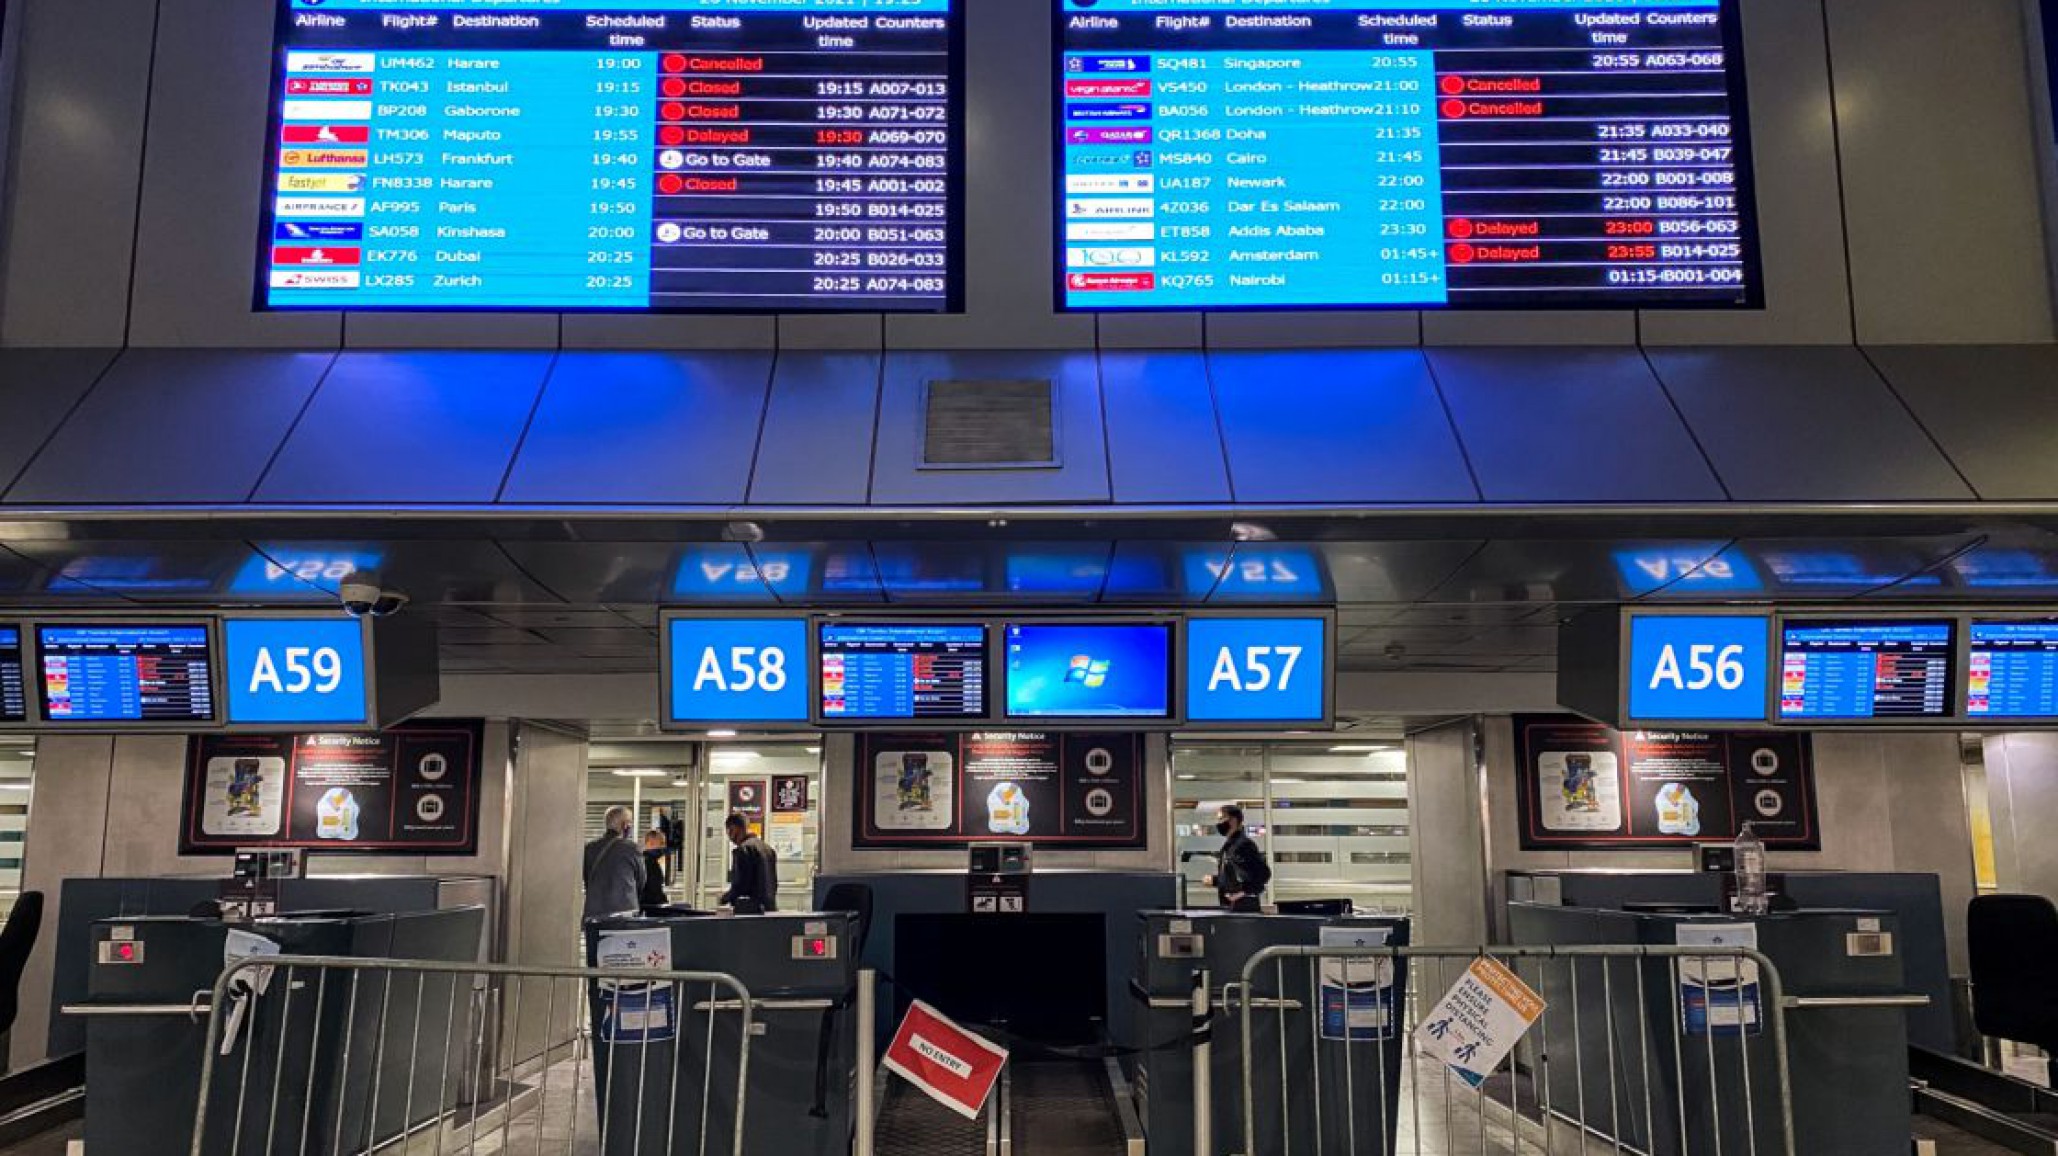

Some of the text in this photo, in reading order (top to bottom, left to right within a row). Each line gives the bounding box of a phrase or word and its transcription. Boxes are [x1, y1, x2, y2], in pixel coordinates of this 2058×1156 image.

[296, 15, 945, 30] Airline Flight# Destination Scheduled Status Updated Counters
[1070, 13, 1718, 29] Airline Flight# Destination Scheduled Status Updated Counters
[610, 35, 853, 46] time time
[1384, 32, 1627, 44] time time
[381, 58, 762, 70] UM462 Harare 19:00 Cancelled
[1157, 53, 1722, 70] SQ481 Singapore 20:55 20:55 A063-068
[382, 81, 946, 95] TK043 Istanbul 19:15 Closed 19:15 A007-013
[1158, 82, 1207, 92] VS450
[1225, 81, 1282, 92] London
[1299, 81, 1373, 91] Heathrow
[1374, 81, 1419, 90] 21:00
[1466, 79, 1540, 90] Cancelled
[377, 105, 945, 119] BP208 Gaborone 19:30 Closed 19:30 A071-072
[1159, 105, 1208, 116] BA056
[1226, 105, 1283, 116] London
[1300, 105, 1374, 115] Heathrow
[1375, 103, 1420, 115] 21:10
[1467, 103, 1541, 114] Cancelled
[378, 129, 945, 143] TM306 Maputo 19:55 Delayed 19:30 A069-070
[1158, 129, 1221, 142] QR1368
[1226, 129, 1266, 140] Doha
[1376, 126, 1421, 138] 21:35
[1599, 125, 1645, 138] 21:35
[1652, 123, 1729, 136] A033-040
[307, 152, 944, 167] Lufthansa LH573 Frankfurt 19:40 Go to Gate 19:40 A074-083
[1159, 147, 1731, 164] MS840 Cairo 21:45 21:45 B039-047
[373, 177, 432, 188] FN8338
[441, 178, 493, 188] Harare
[592, 178, 636, 189] 19:45
[683, 178, 736, 190] Closed
[817, 179, 862, 191] 19:45
[868, 180, 944, 192] A001-002
[1160, 171, 1733, 189] UA187 Newark 22:00 22:00 B001-008
[371, 202, 419, 212] AF995
[439, 202, 476, 213] Paris
[591, 202, 636, 213] 19:50
[816, 204, 862, 215] 19:50
[869, 204, 944, 217] B014-025
[1160, 202, 1209, 213] 4Z036
[1228, 202, 1254, 212] Dar
[1260, 200, 1279, 212] Es
[1284, 201, 1340, 211] Salaam
[1380, 199, 1424, 211] 22:00
[1604, 197, 1651, 209] 22:00
[1657, 196, 1735, 208] B086-101
[369, 226, 944, 241] SA058 Kinshasa 20:00 Go to Gate 20:00 B051-063
[1161, 220, 1738, 237] ET858 Addis Ababa 23:30 Delayed 23:00 B056-063
[367, 250, 944, 265] EK776 Dubai 20:25 20:25 B026-033
[1161, 244, 1740, 262] KL592 Amsterdam 01:45+ Delayed 23:55 B014-025
[365, 275, 413, 287] LX285
[434, 275, 482, 286] Zurich
[587, 276, 632, 288] 20:25
[814, 277, 860, 290] 20:25
[867, 278, 943, 291] A074-083
[1161, 274, 1213, 289] KQ765
[1230, 275, 1285, 285] Nairobi
[1382, 272, 1438, 284] 01:15+
[1664, 269, 1742, 281] B001-004
[249, 647, 342, 693] A59
[693, 646, 786, 691] A58
[1207, 646, 1302, 691] A57
[1649, 644, 1744, 689] A56
[1465, 978, 1493, 1003] PLEASE
[1458, 986, 1489, 1015] ENSURE
[1451, 994, 1488, 1030] PHYSICAL
[920, 1043, 962, 1070] NO ENTRY
